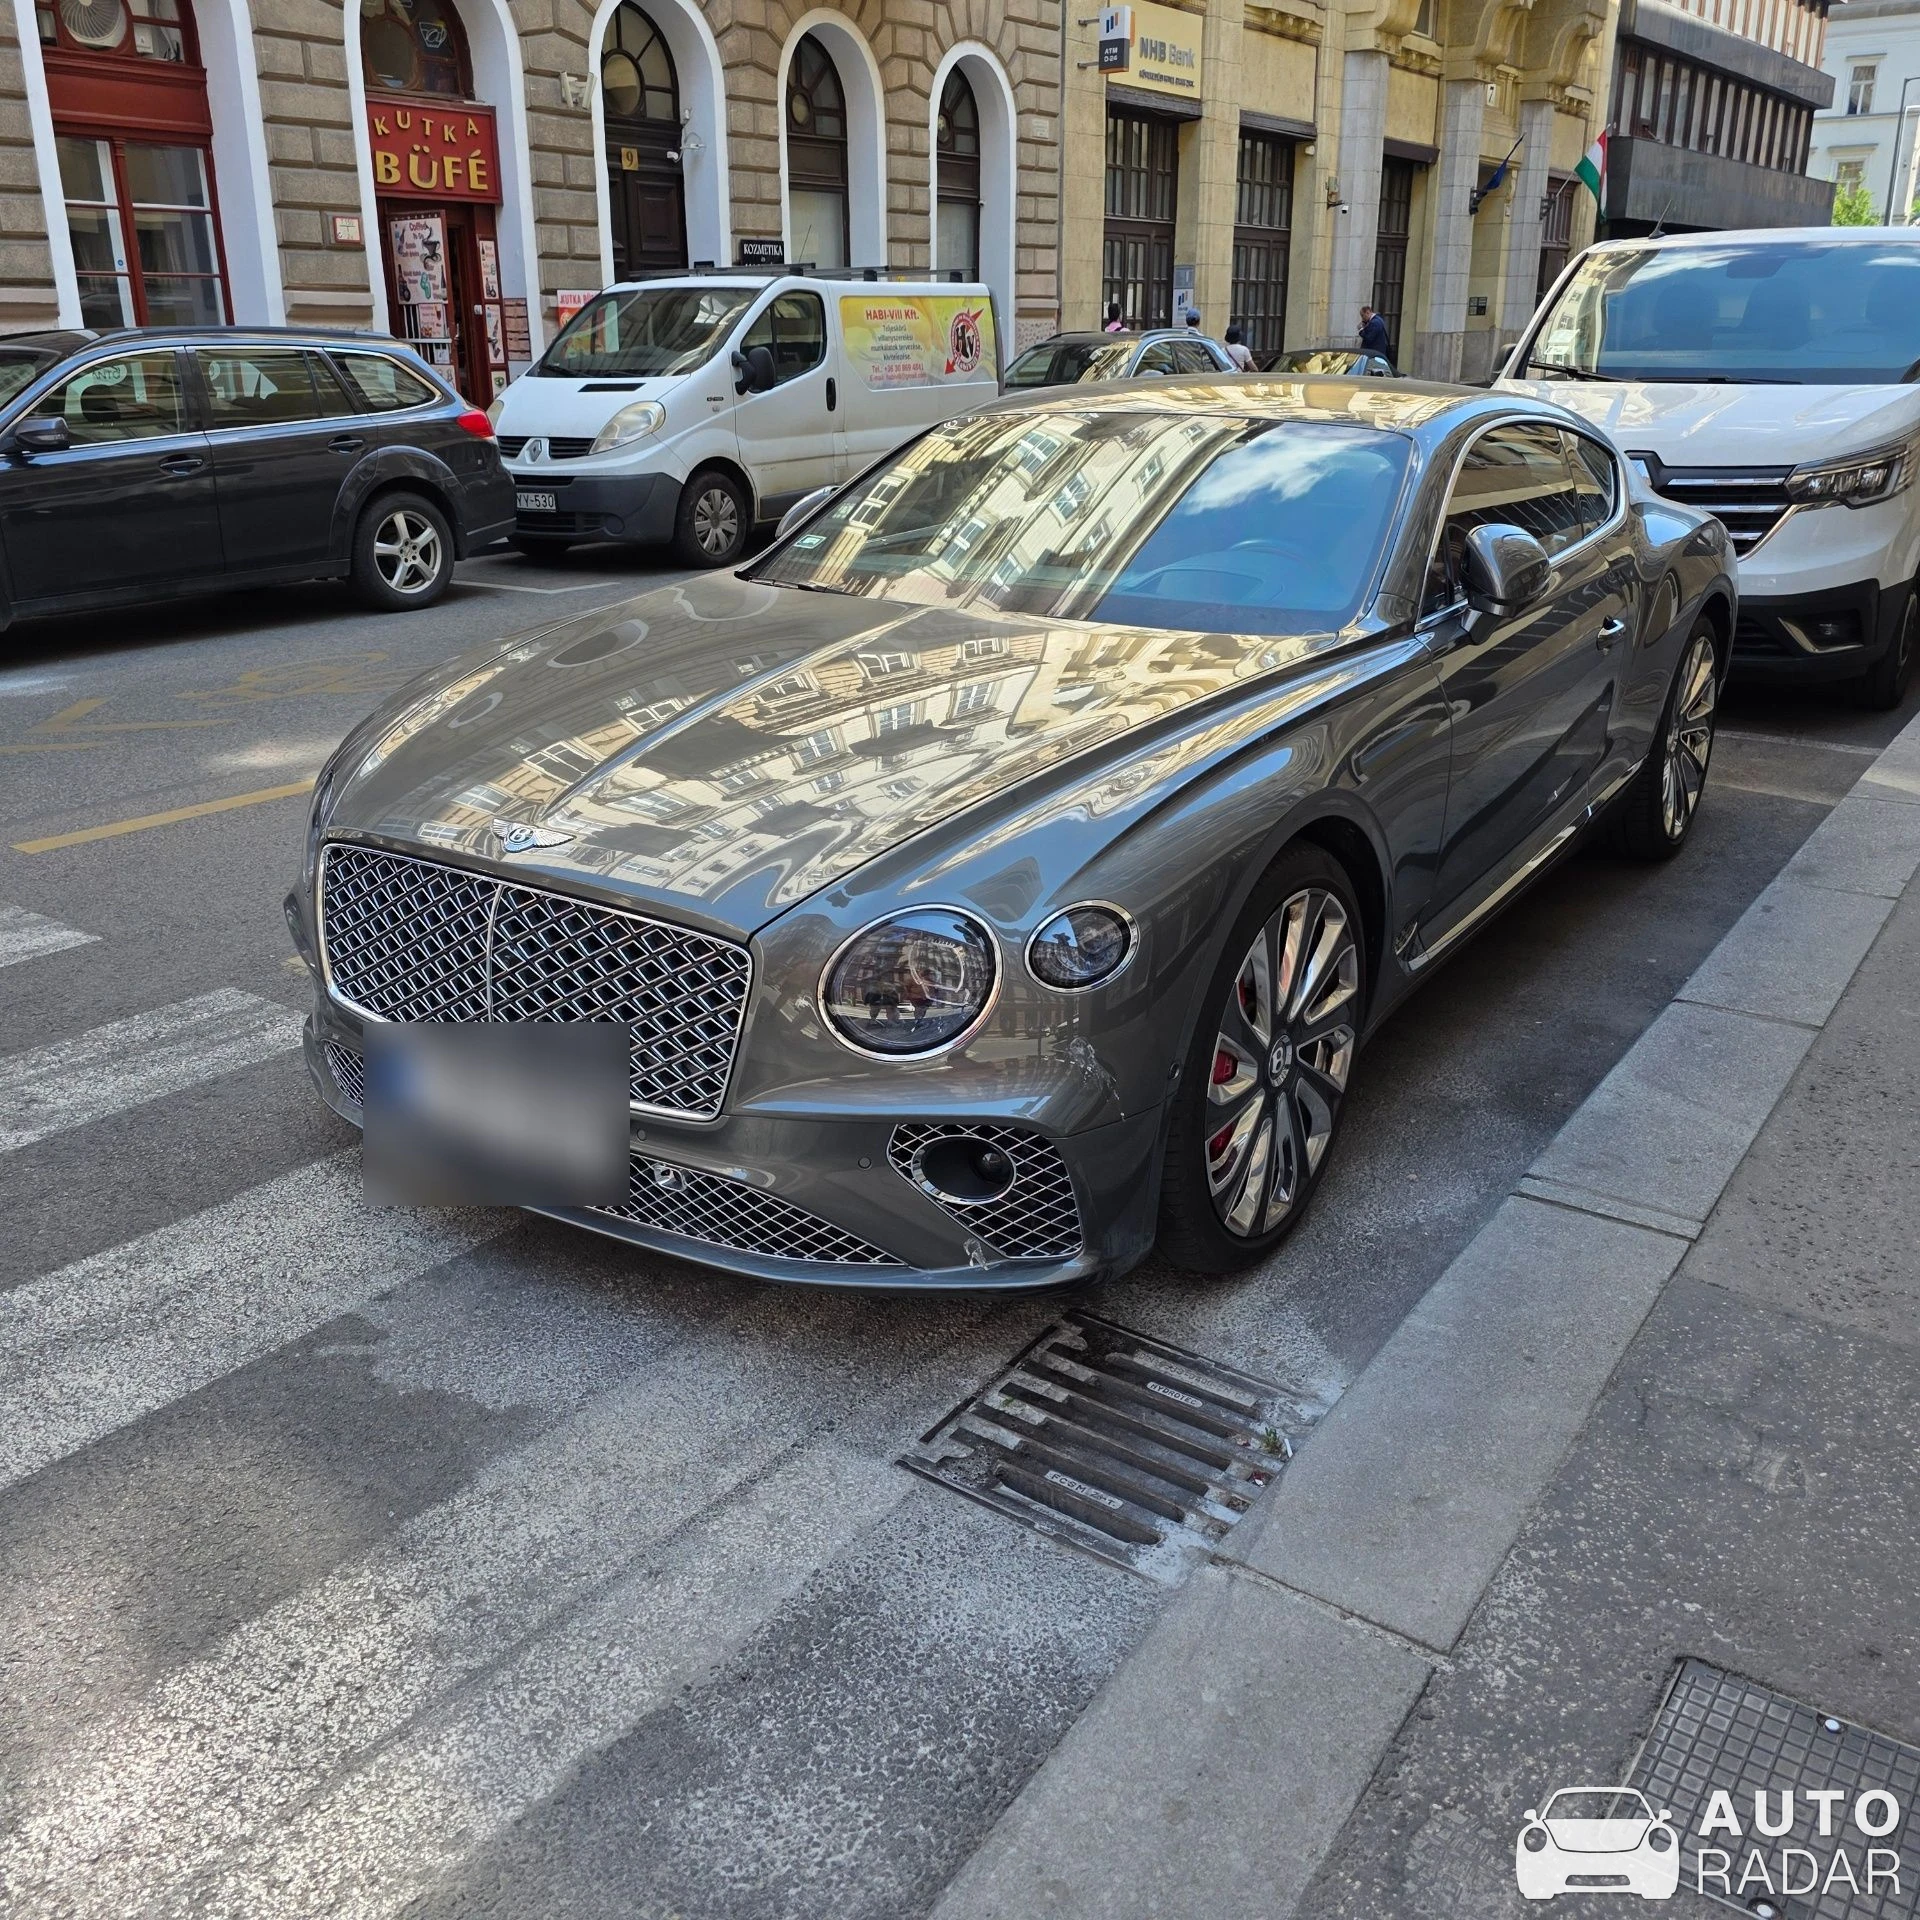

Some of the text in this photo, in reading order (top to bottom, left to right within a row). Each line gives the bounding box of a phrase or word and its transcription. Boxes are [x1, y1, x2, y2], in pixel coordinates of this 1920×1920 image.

[1104, 47, 1118, 55] ATM
[1140, 37, 1195, 69] NHB Bank
[1489, 86, 1495, 103] 7
[374, 110, 479, 143] KUTKA
[375, 144, 489, 189] BÜFÉ
[626, 150, 634, 168] 9
[743, 243, 783, 256] KOZMETIKA
[560, 294, 581, 305] KUTKA
[865, 308, 920, 320] HABI-Vill Kft.
[516, 494, 554, 508] YY-530
[1150, 1383, 1198, 1405] HYDROTEC
[1051, 1473, 1087, 1494] FCSM
